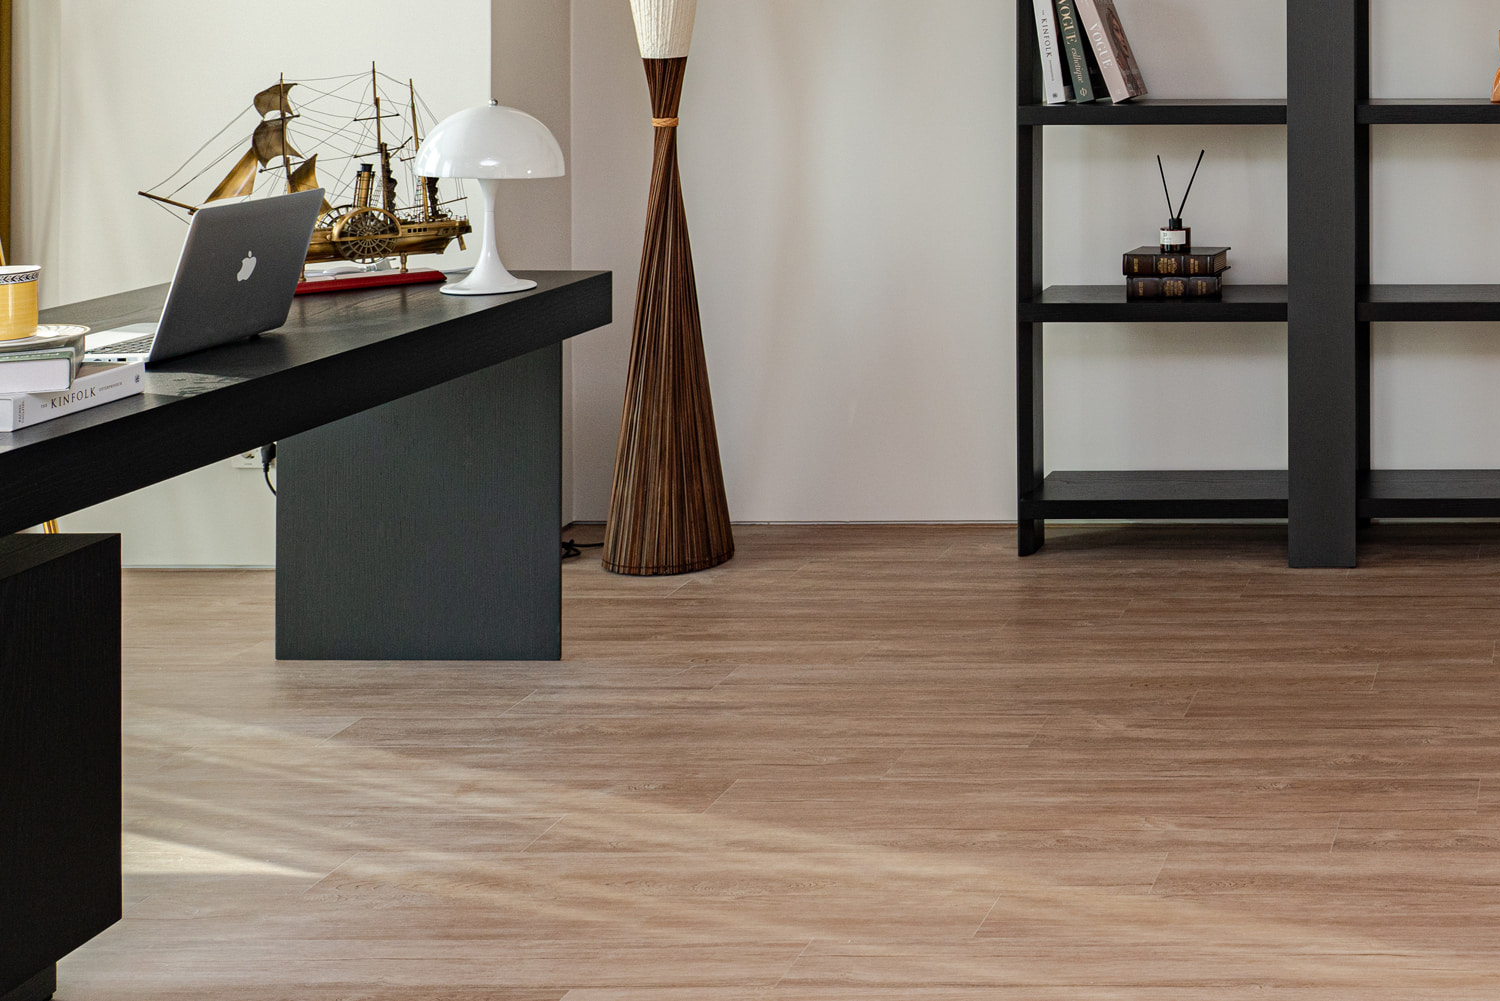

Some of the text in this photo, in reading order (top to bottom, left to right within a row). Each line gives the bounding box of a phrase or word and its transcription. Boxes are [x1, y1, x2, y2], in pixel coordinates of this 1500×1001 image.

[1041, 18, 1053, 58] KINFOLK
[1089, 23, 1113, 69] VOGUE
[51, 386, 97, 409] KINFOLK
